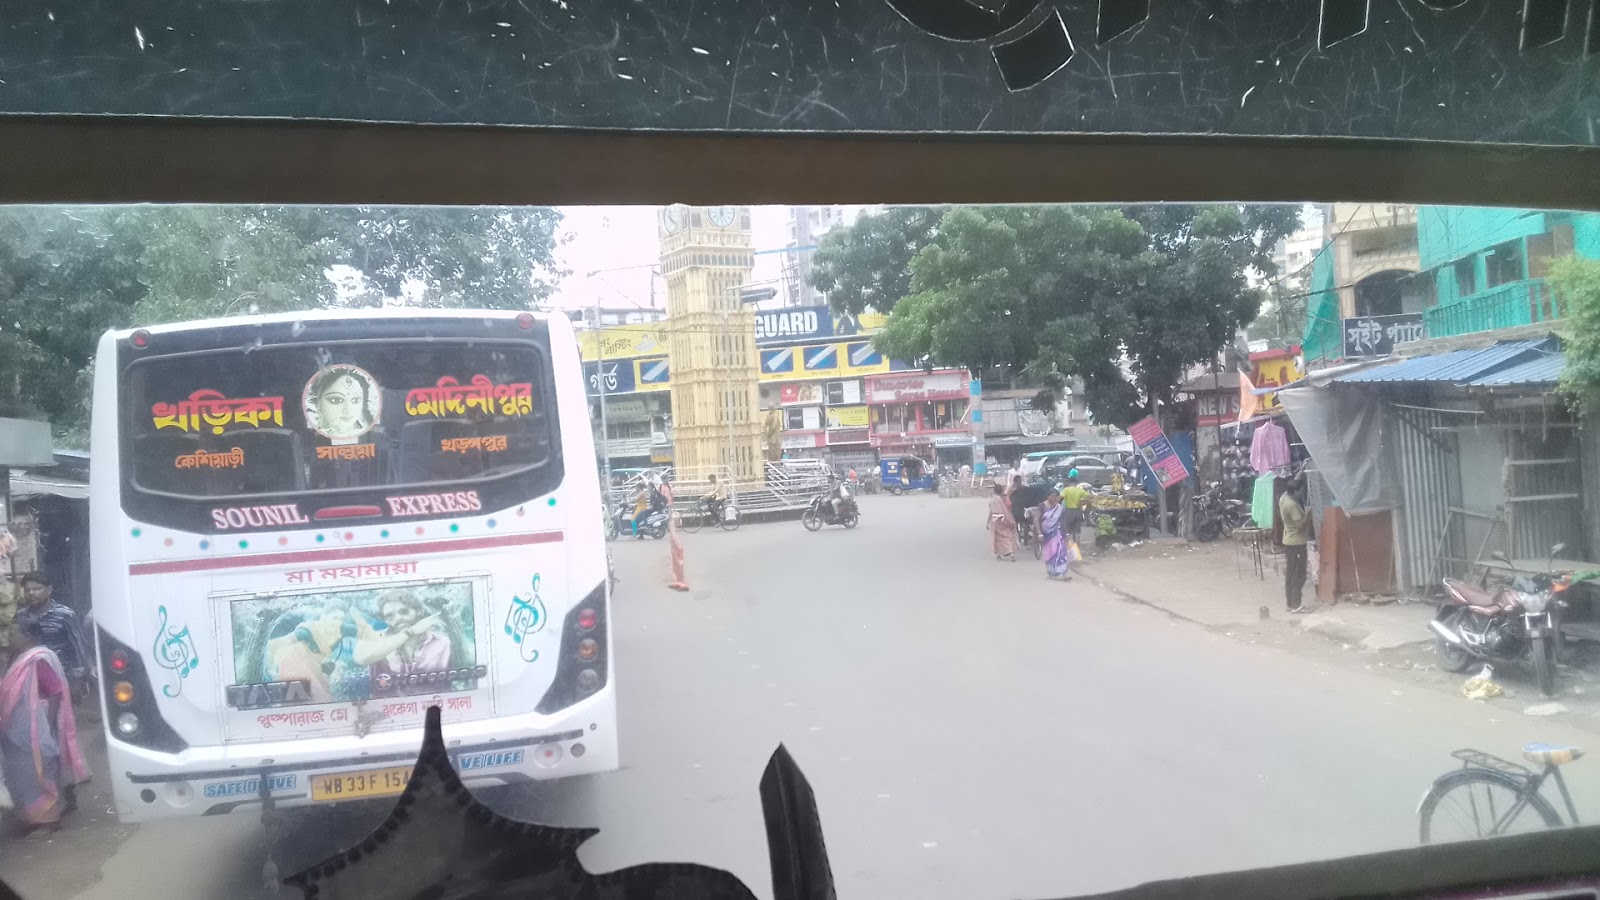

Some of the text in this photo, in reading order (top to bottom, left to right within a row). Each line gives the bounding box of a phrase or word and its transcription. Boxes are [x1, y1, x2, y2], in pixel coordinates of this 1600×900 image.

[755, 310, 818, 339] GUARD
[590, 364, 618, 391] গর্ড
[404, 374, 533, 418] মেদিনীপুর
[211, 490, 482, 529] SOUNIL EXPRESS
[284, 561, 419, 584] মা মহামায়া
[229, 680, 311, 706] TATA
[448, 696, 472, 710] সালা
[460, 750, 523, 770] VE LIFE
[205, 781, 244, 797] SAFE
[323, 770, 410, 794] WB 33 F 154
